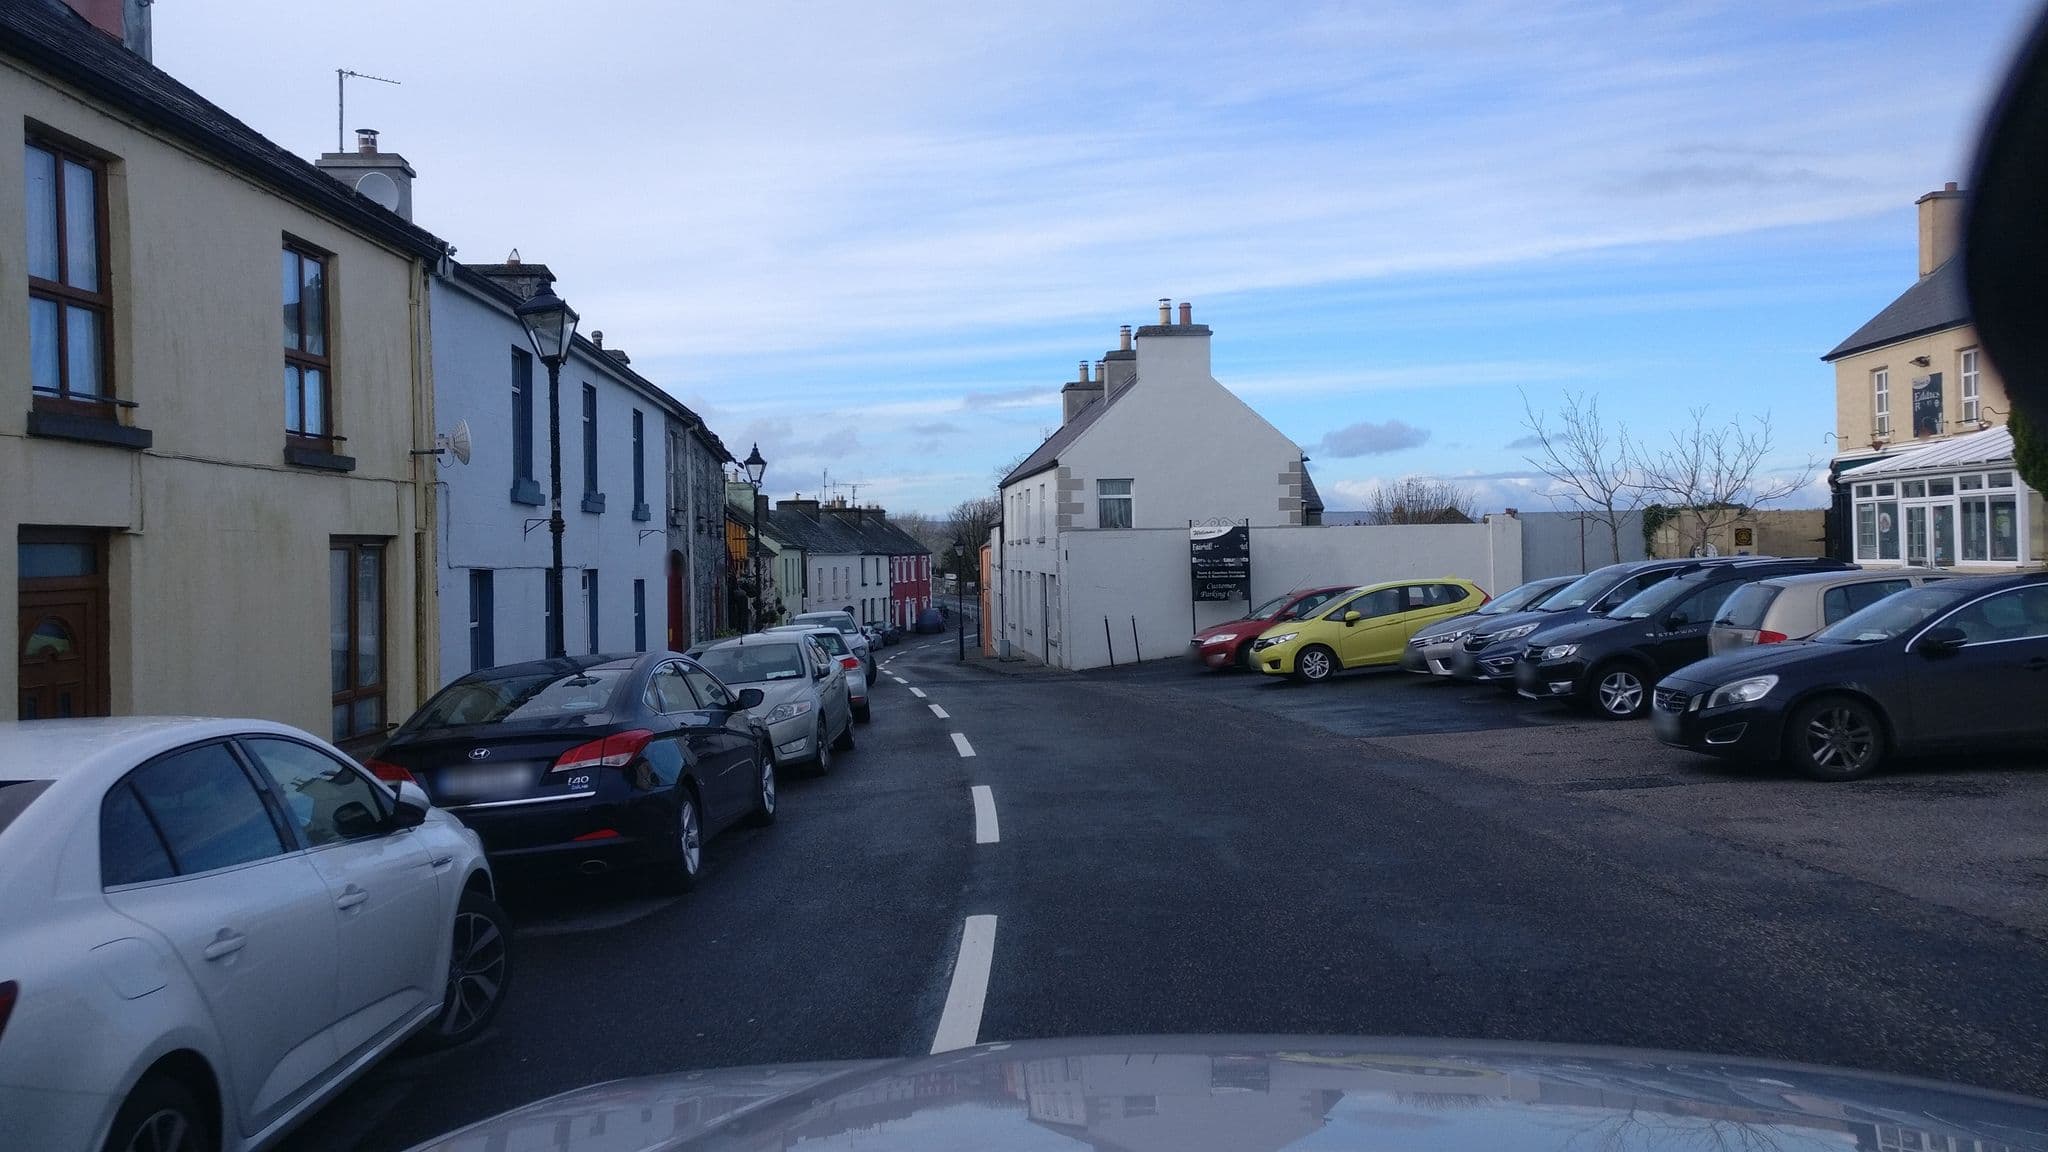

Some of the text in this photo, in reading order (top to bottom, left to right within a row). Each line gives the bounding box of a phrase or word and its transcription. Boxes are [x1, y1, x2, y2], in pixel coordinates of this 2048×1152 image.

[1206, 582, 1237, 590] Customer
[1200, 589, 1243, 599] Parking Oly
